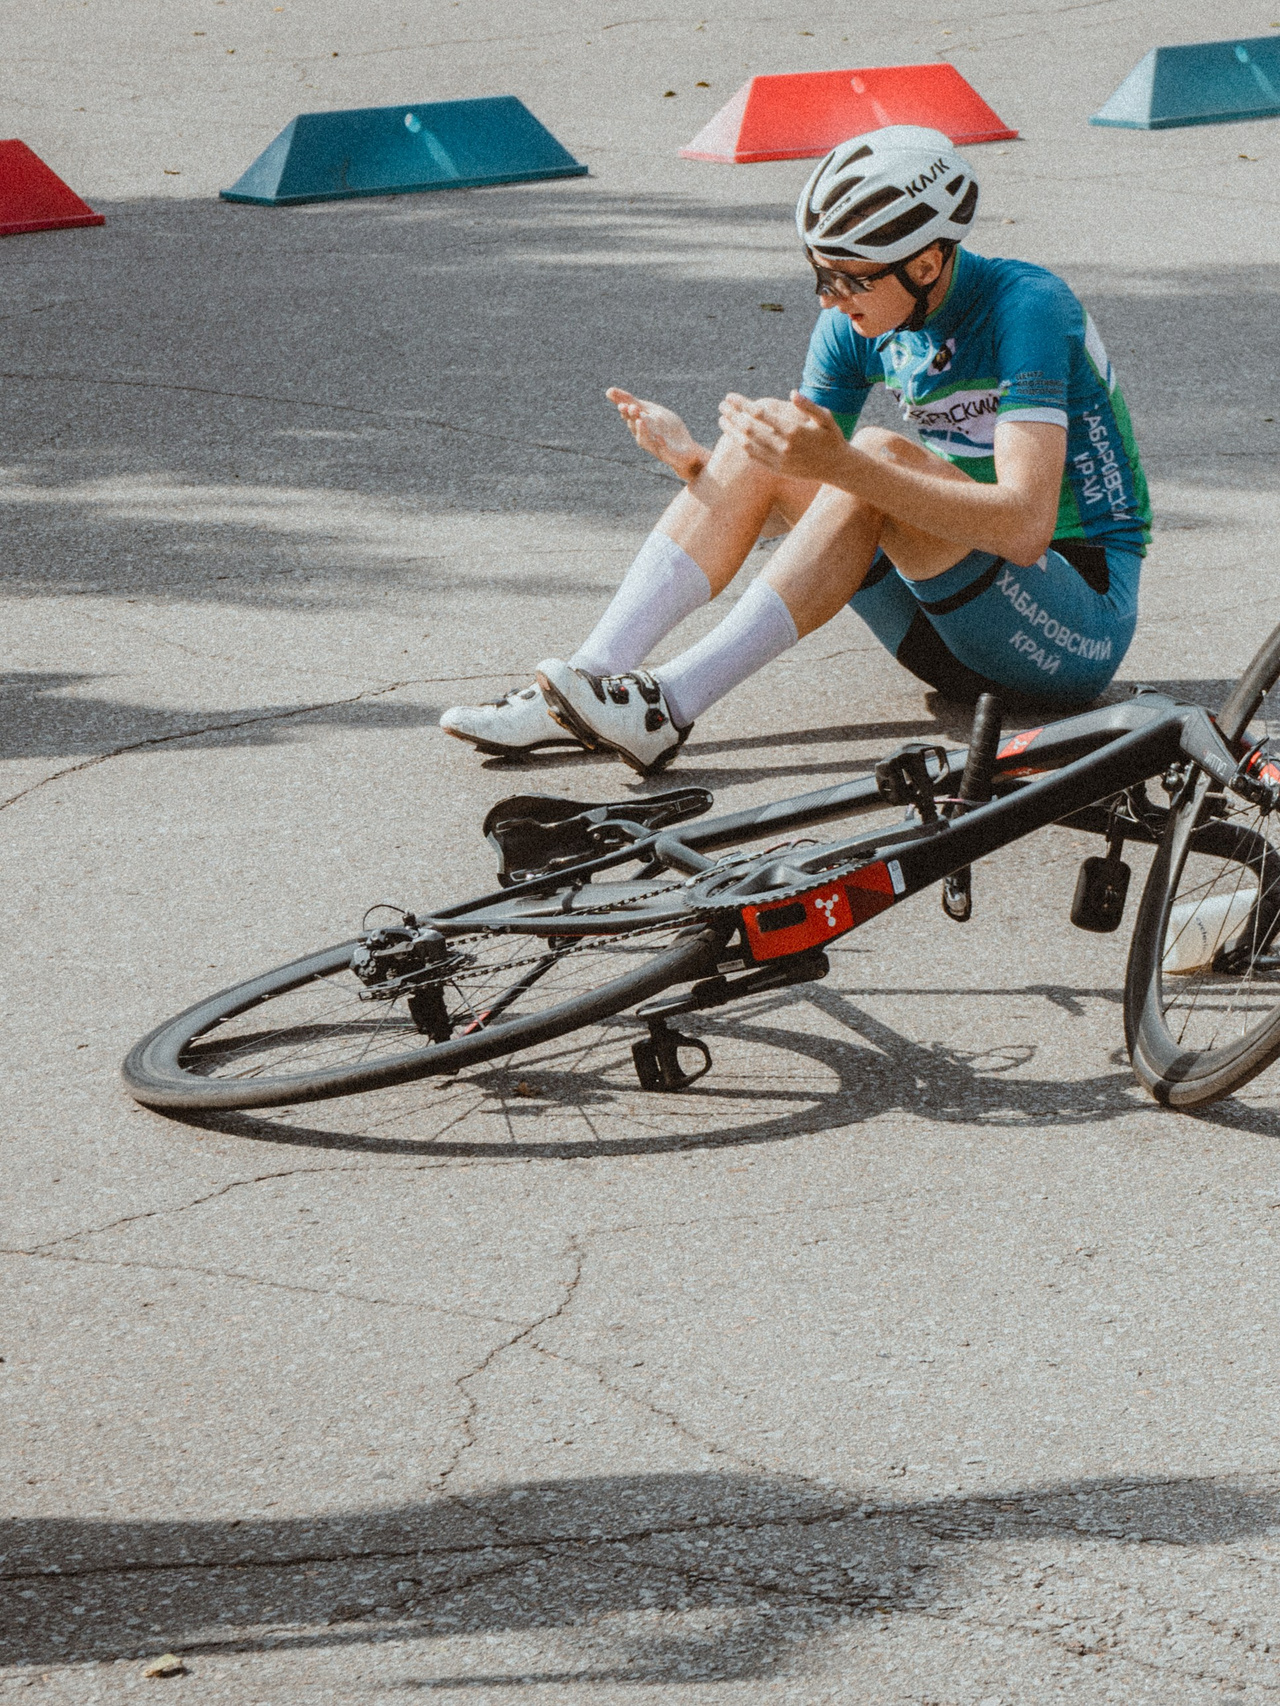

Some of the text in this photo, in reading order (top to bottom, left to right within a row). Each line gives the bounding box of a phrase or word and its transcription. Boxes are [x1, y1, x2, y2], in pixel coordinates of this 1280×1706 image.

[904, 157, 951, 199] KASK
[996, 569, 1112, 661] ХАБАРОВСКИЙ
[1009, 630, 1062, 676] КРАЙ
